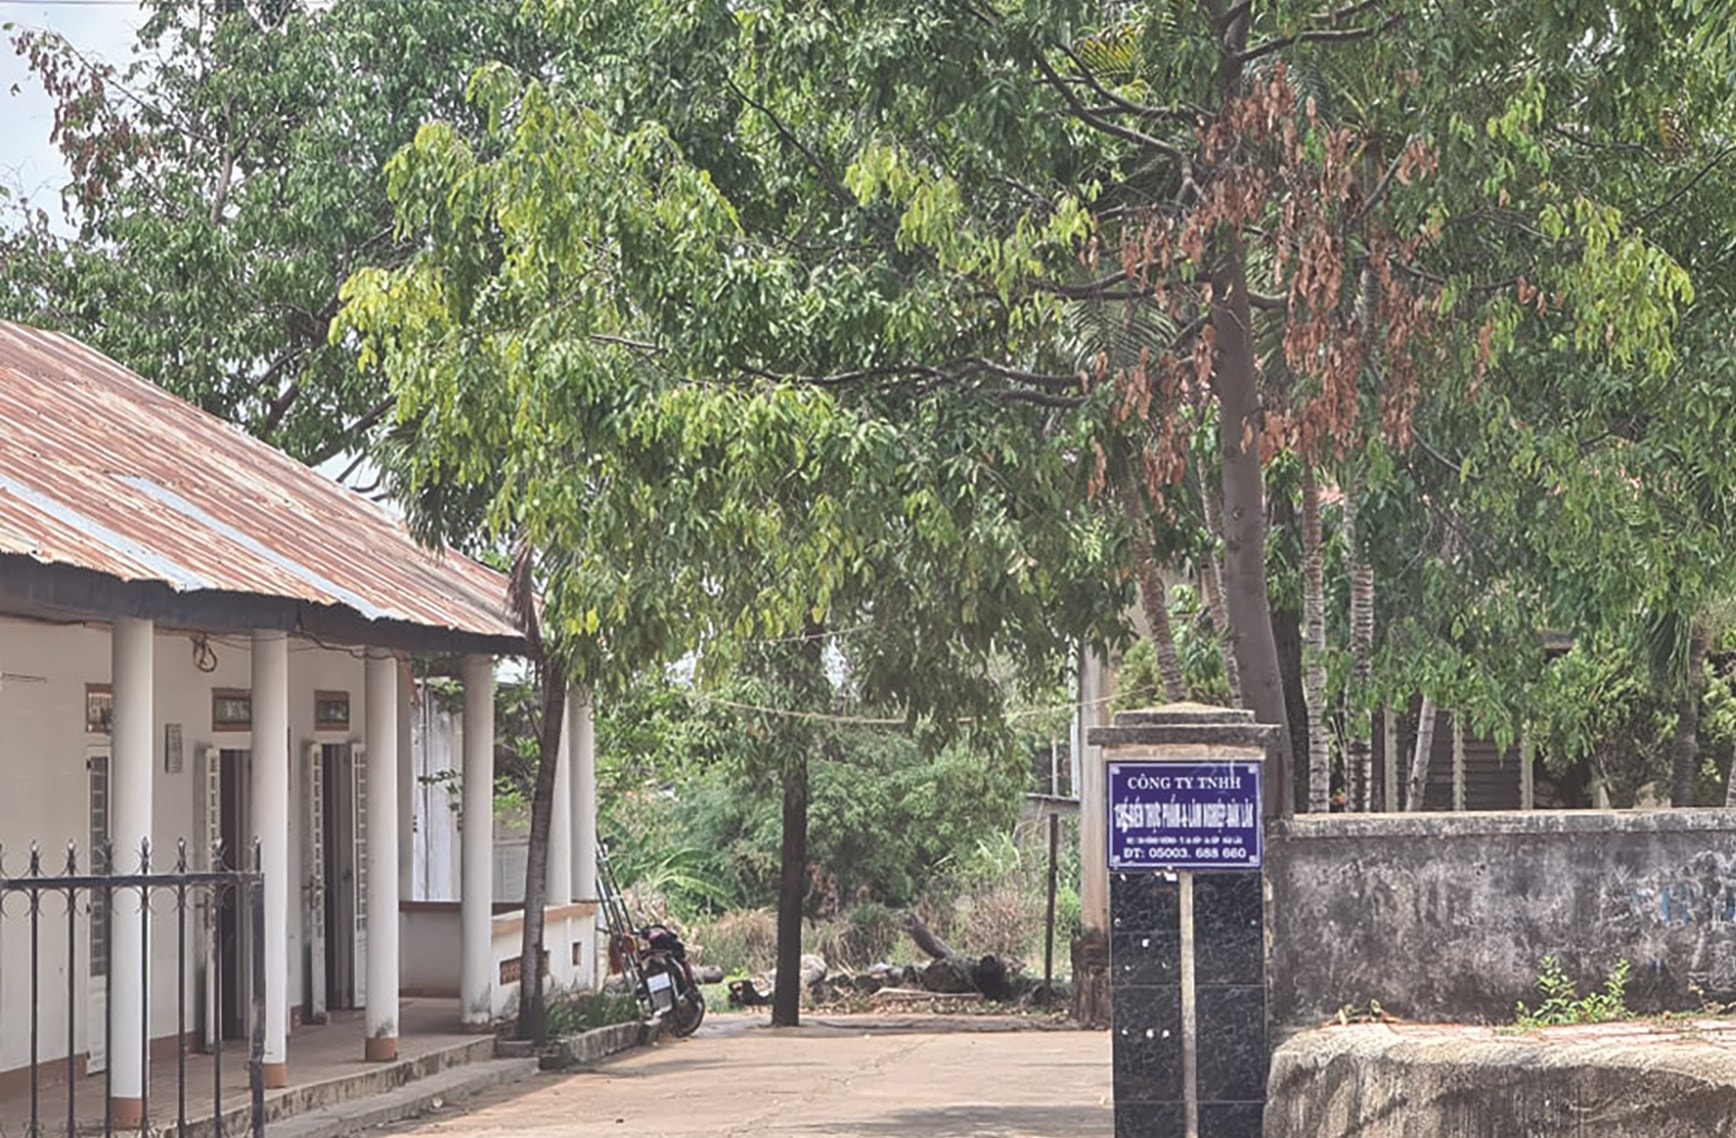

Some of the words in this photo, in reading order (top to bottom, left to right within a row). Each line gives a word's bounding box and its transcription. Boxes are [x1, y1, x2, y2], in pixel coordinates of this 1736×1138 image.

[1127, 773, 1171, 789] CÔNG
[1174, 776, 1194, 789] TY
[1196, 776, 1241, 789] TNHH
